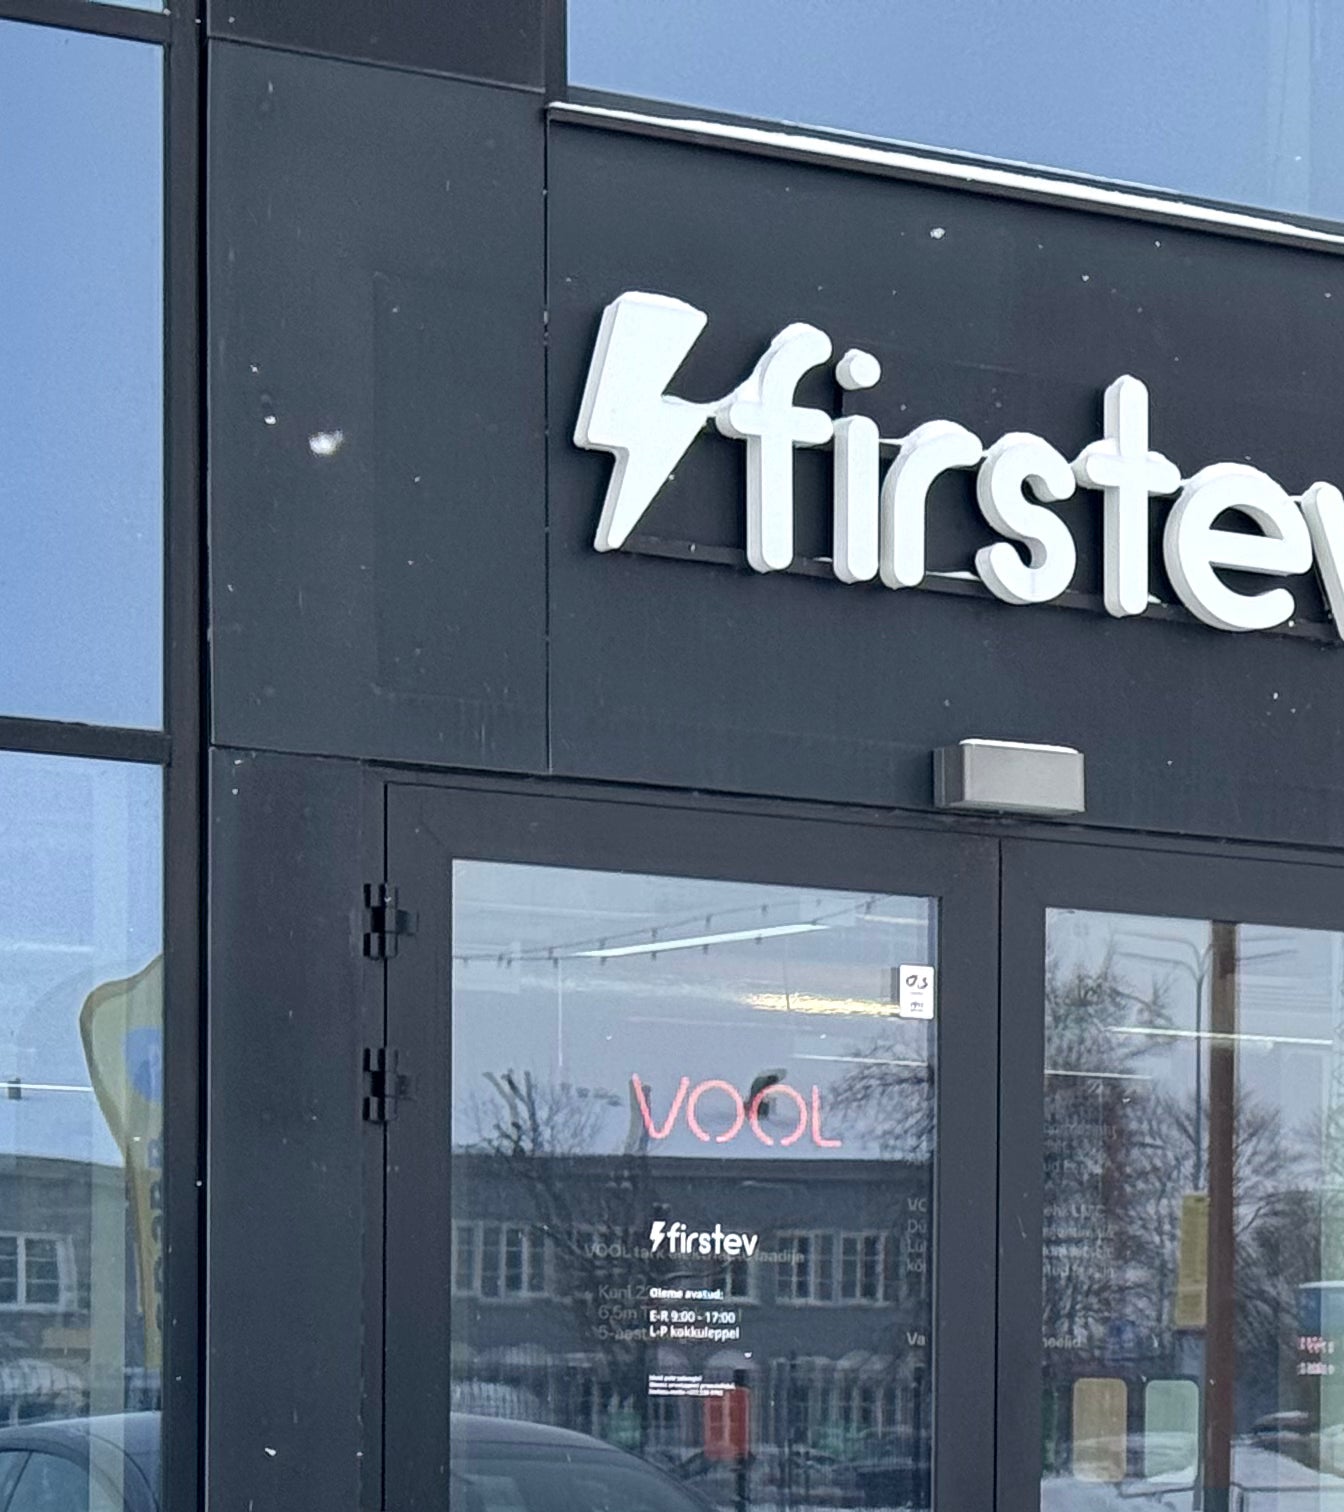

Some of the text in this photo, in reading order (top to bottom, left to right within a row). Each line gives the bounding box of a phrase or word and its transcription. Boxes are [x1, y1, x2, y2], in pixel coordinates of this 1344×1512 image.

[632, 1073, 843, 1149] VOOL
[666, 1222, 758, 1256] firstev
[705, 1311, 736, 1324] 17:00
